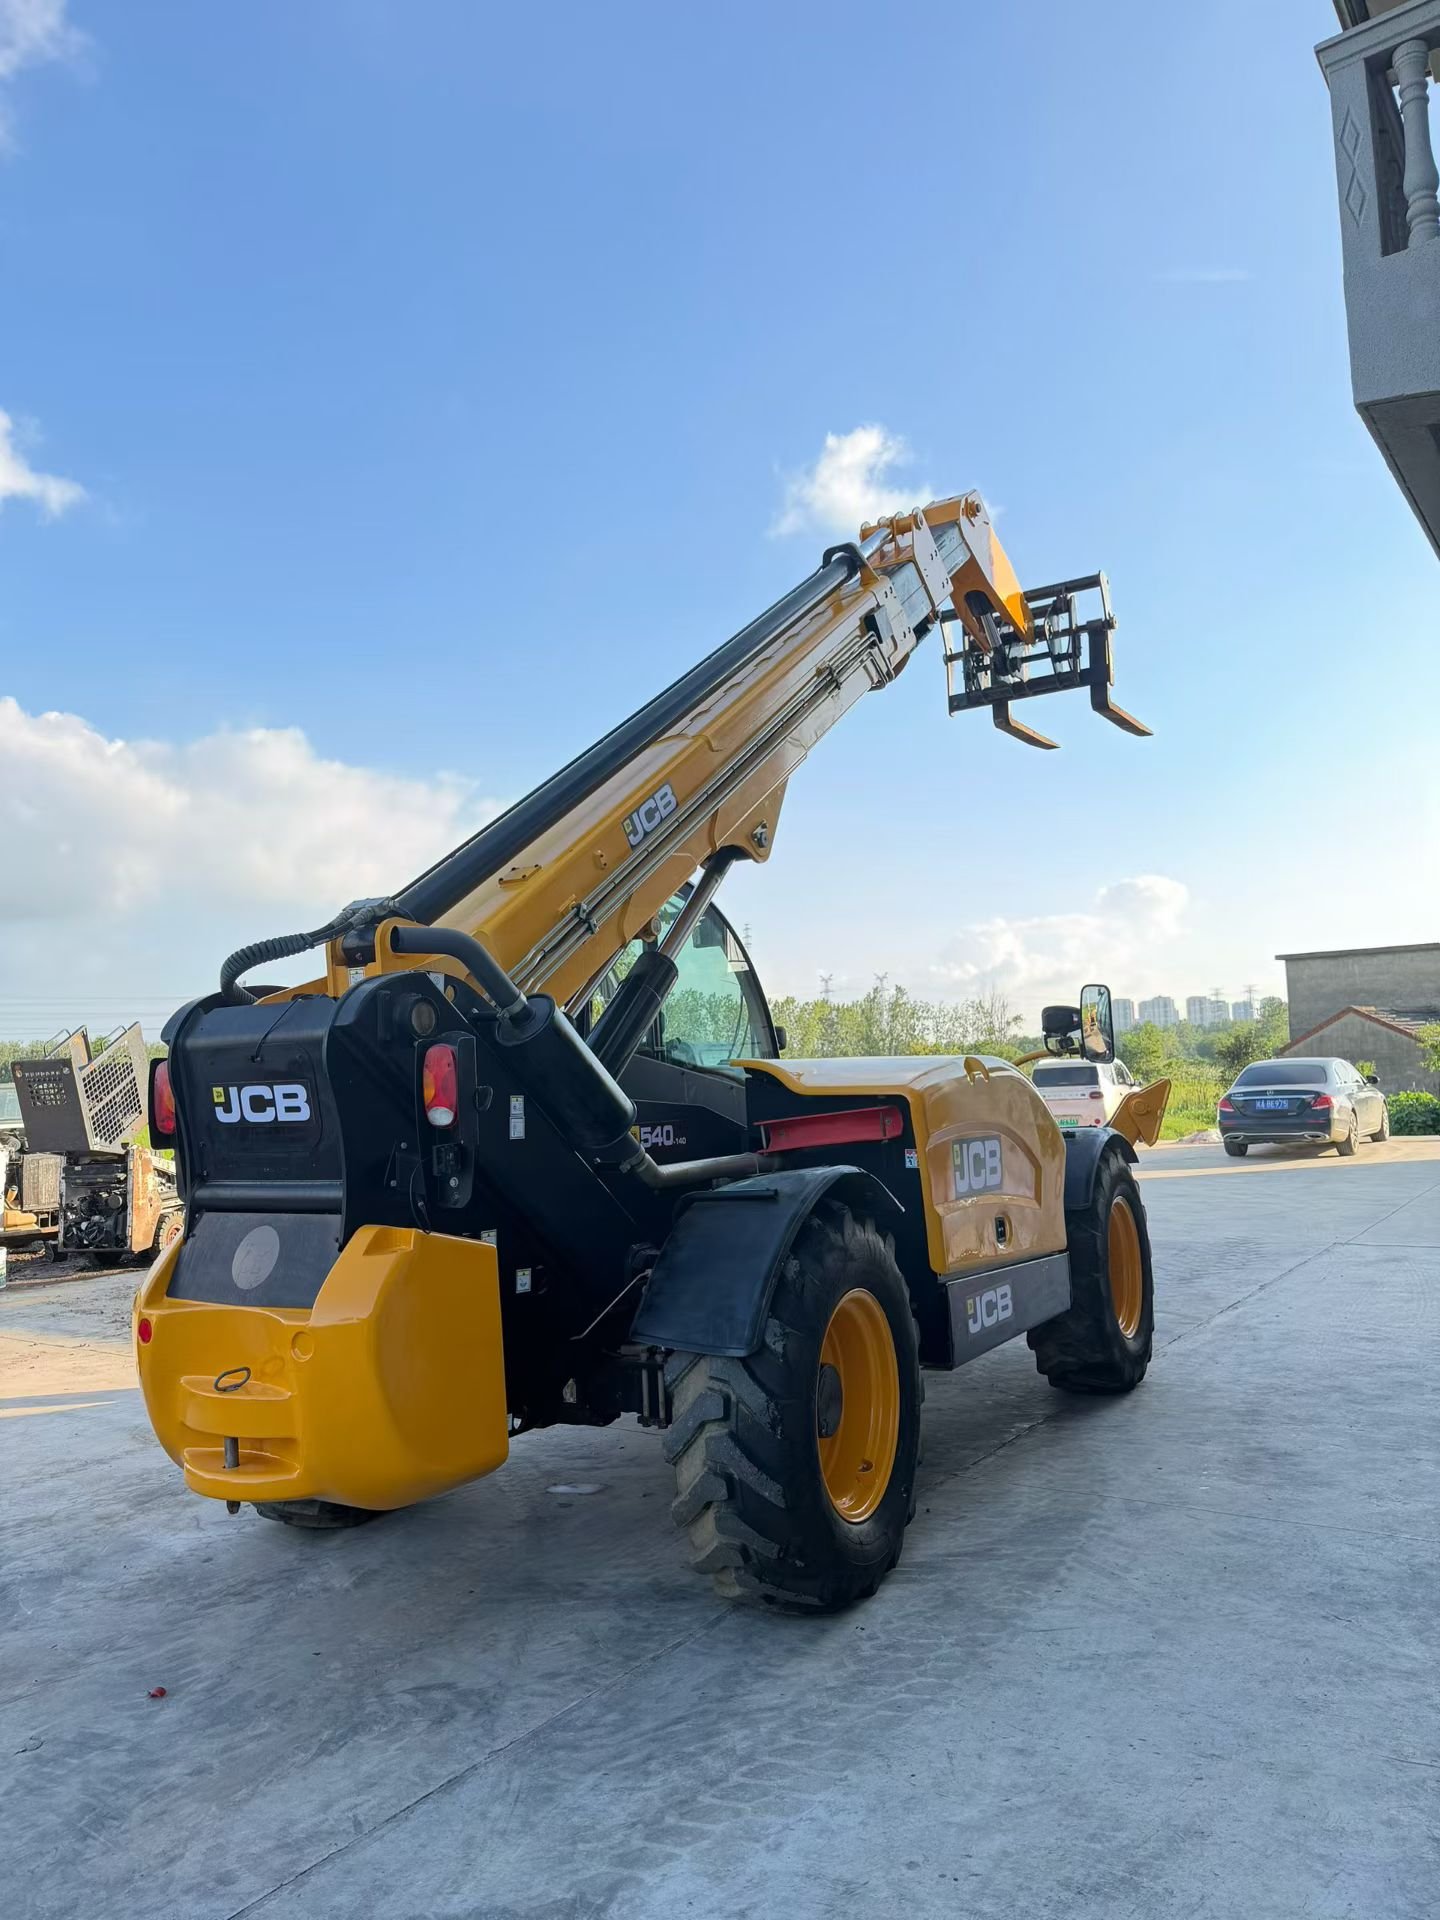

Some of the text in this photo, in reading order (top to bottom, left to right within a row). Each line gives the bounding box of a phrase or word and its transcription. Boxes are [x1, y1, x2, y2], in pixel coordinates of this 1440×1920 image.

[629, 784, 677, 846] JCB
[214, 1084, 311, 1123] JCB
[955, 1139, 1002, 1192] JCB
[968, 1284, 1013, 1334] JCB
